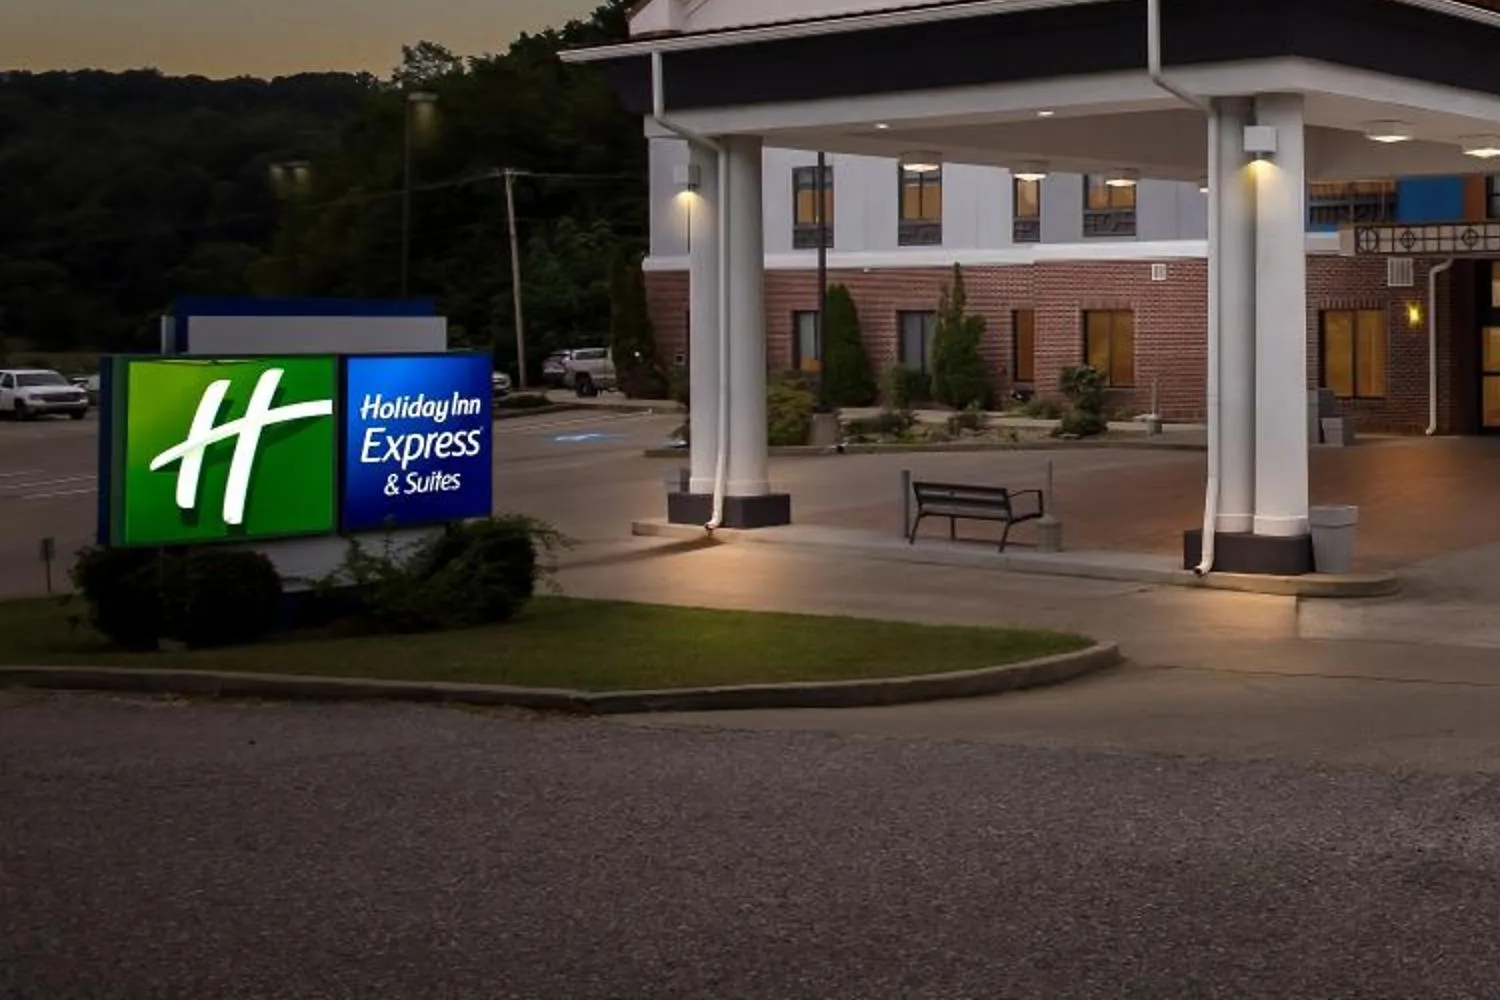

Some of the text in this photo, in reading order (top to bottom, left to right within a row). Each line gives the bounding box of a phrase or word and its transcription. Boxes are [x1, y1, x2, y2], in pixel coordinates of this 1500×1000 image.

[360, 391, 481, 423] Holiday Inn
[360, 426, 481, 470] Express
[383, 470, 461, 496] & Suites
